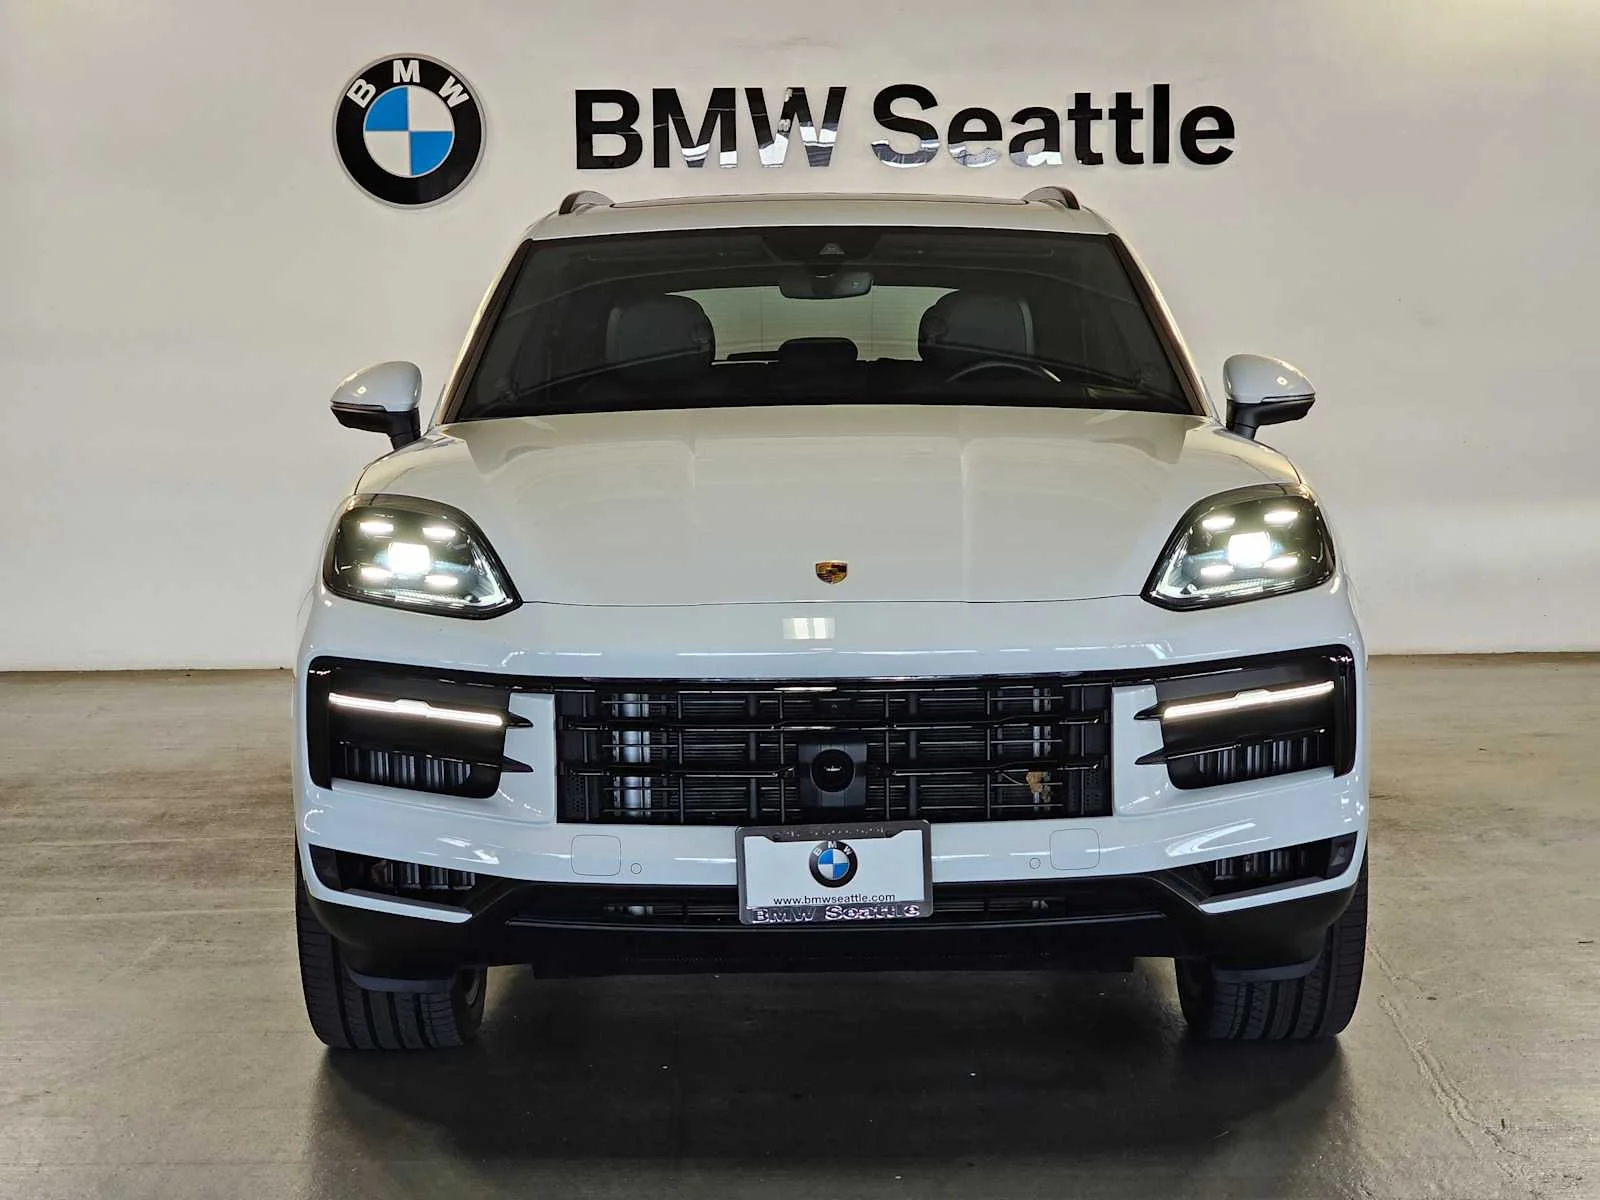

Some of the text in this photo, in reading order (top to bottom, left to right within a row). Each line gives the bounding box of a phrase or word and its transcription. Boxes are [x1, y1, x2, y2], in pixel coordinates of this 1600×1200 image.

[347, 59, 469, 109] BMW
[575, 84, 1236, 170] BMW Seattle
[813, 840, 852, 856] BMW
[773, 893, 896, 905] www.bmwseattle.com
[752, 904, 920, 924] BMW Seattle
